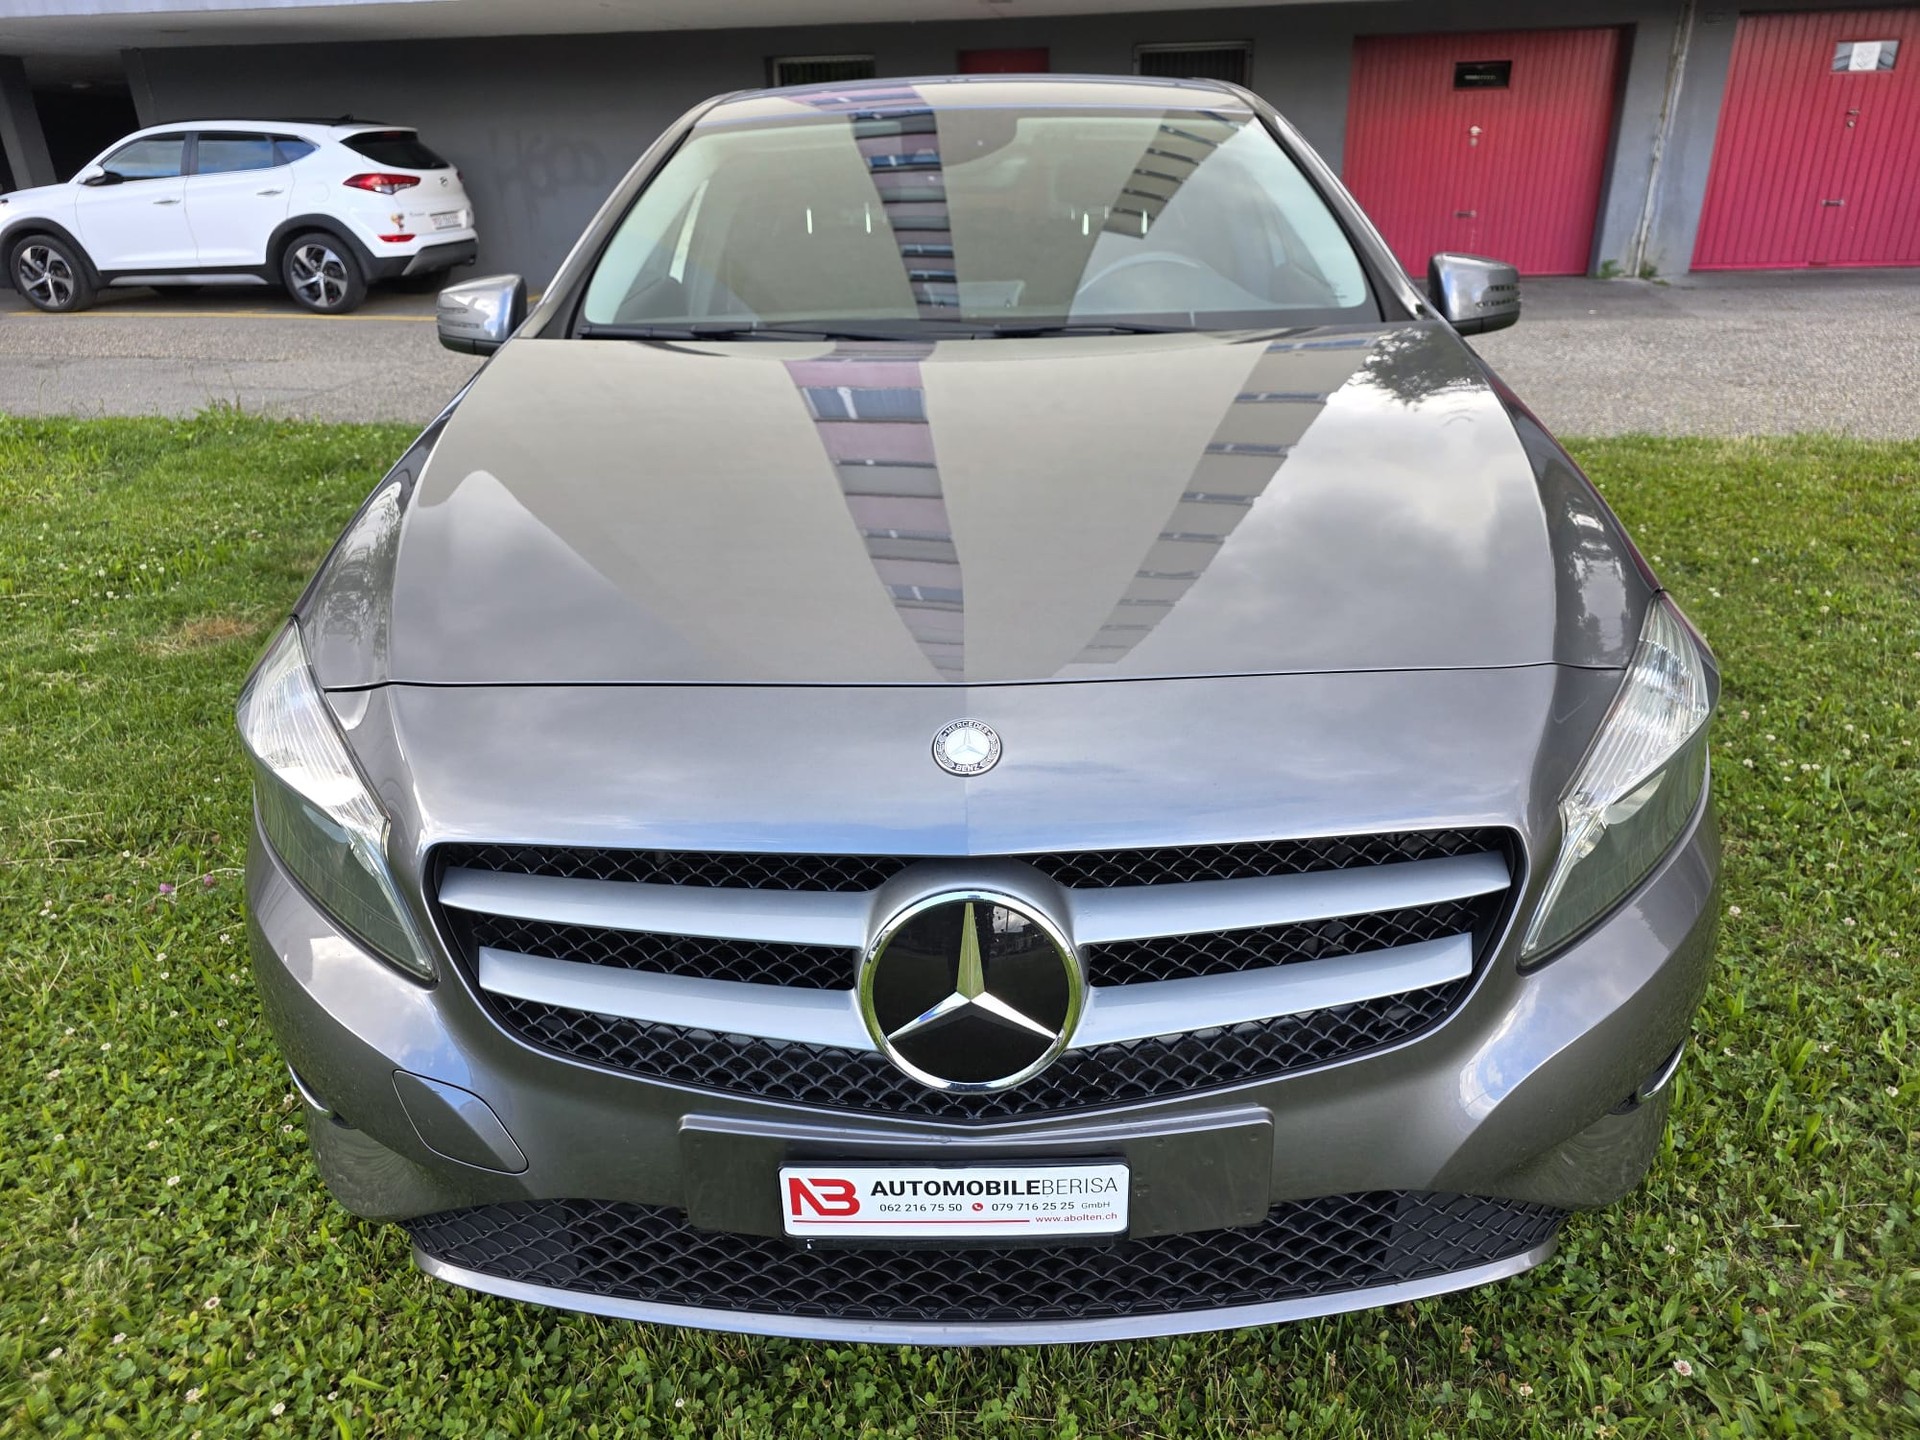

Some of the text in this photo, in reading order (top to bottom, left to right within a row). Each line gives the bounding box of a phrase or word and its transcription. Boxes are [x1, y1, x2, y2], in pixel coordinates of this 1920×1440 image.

[955, 763, 981, 772] BENZ
[870, 1177, 1118, 1196] AUTOMOBILEBERISA
[879, 1201, 1111, 1212] 062 216 75 50 079 716 25 25 GmbH
[1035, 1212, 1118, 1223] www.abolten.ch
